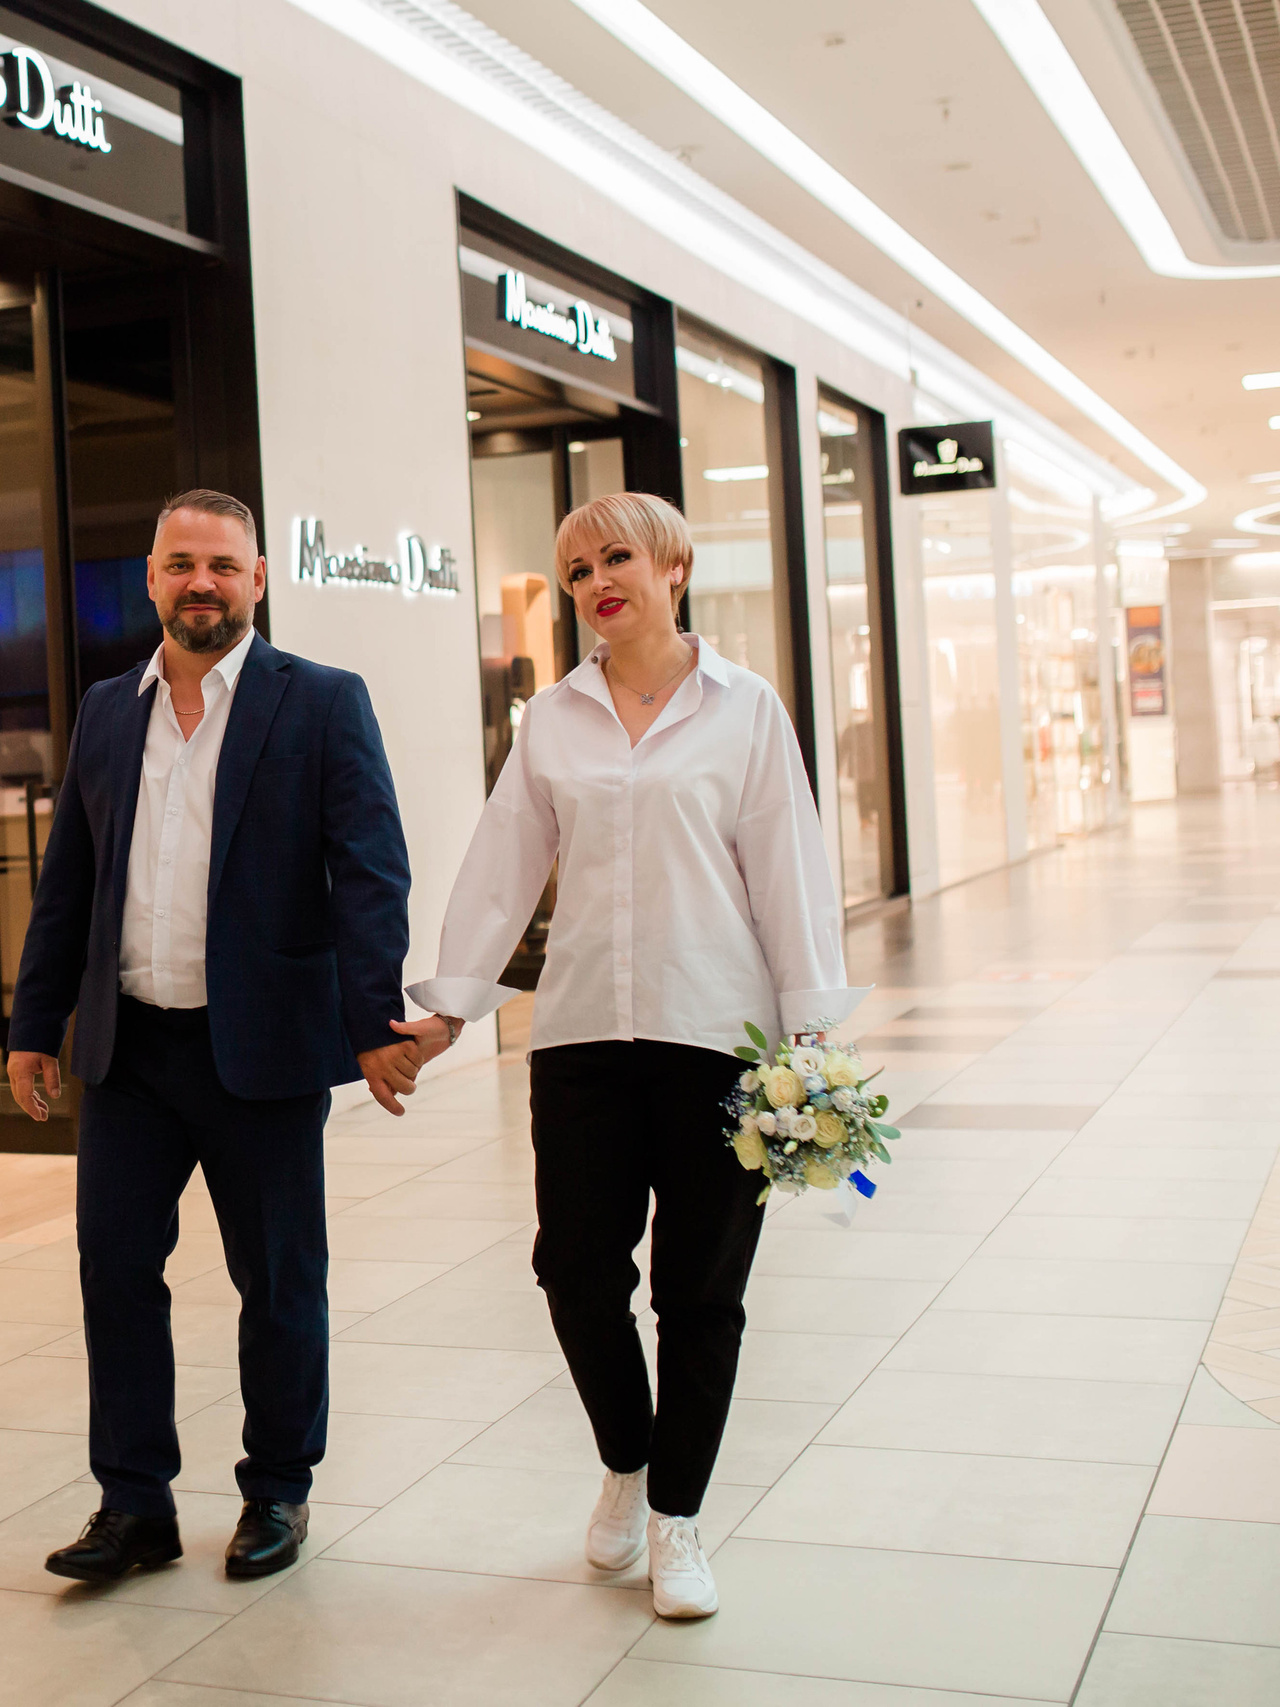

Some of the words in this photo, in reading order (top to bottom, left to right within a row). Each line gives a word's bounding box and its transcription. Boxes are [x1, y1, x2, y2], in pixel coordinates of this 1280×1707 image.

[12, 47, 112, 153] Dutti
[505, 268, 577, 345] Massimo
[292, 516, 401, 588] Massimo
